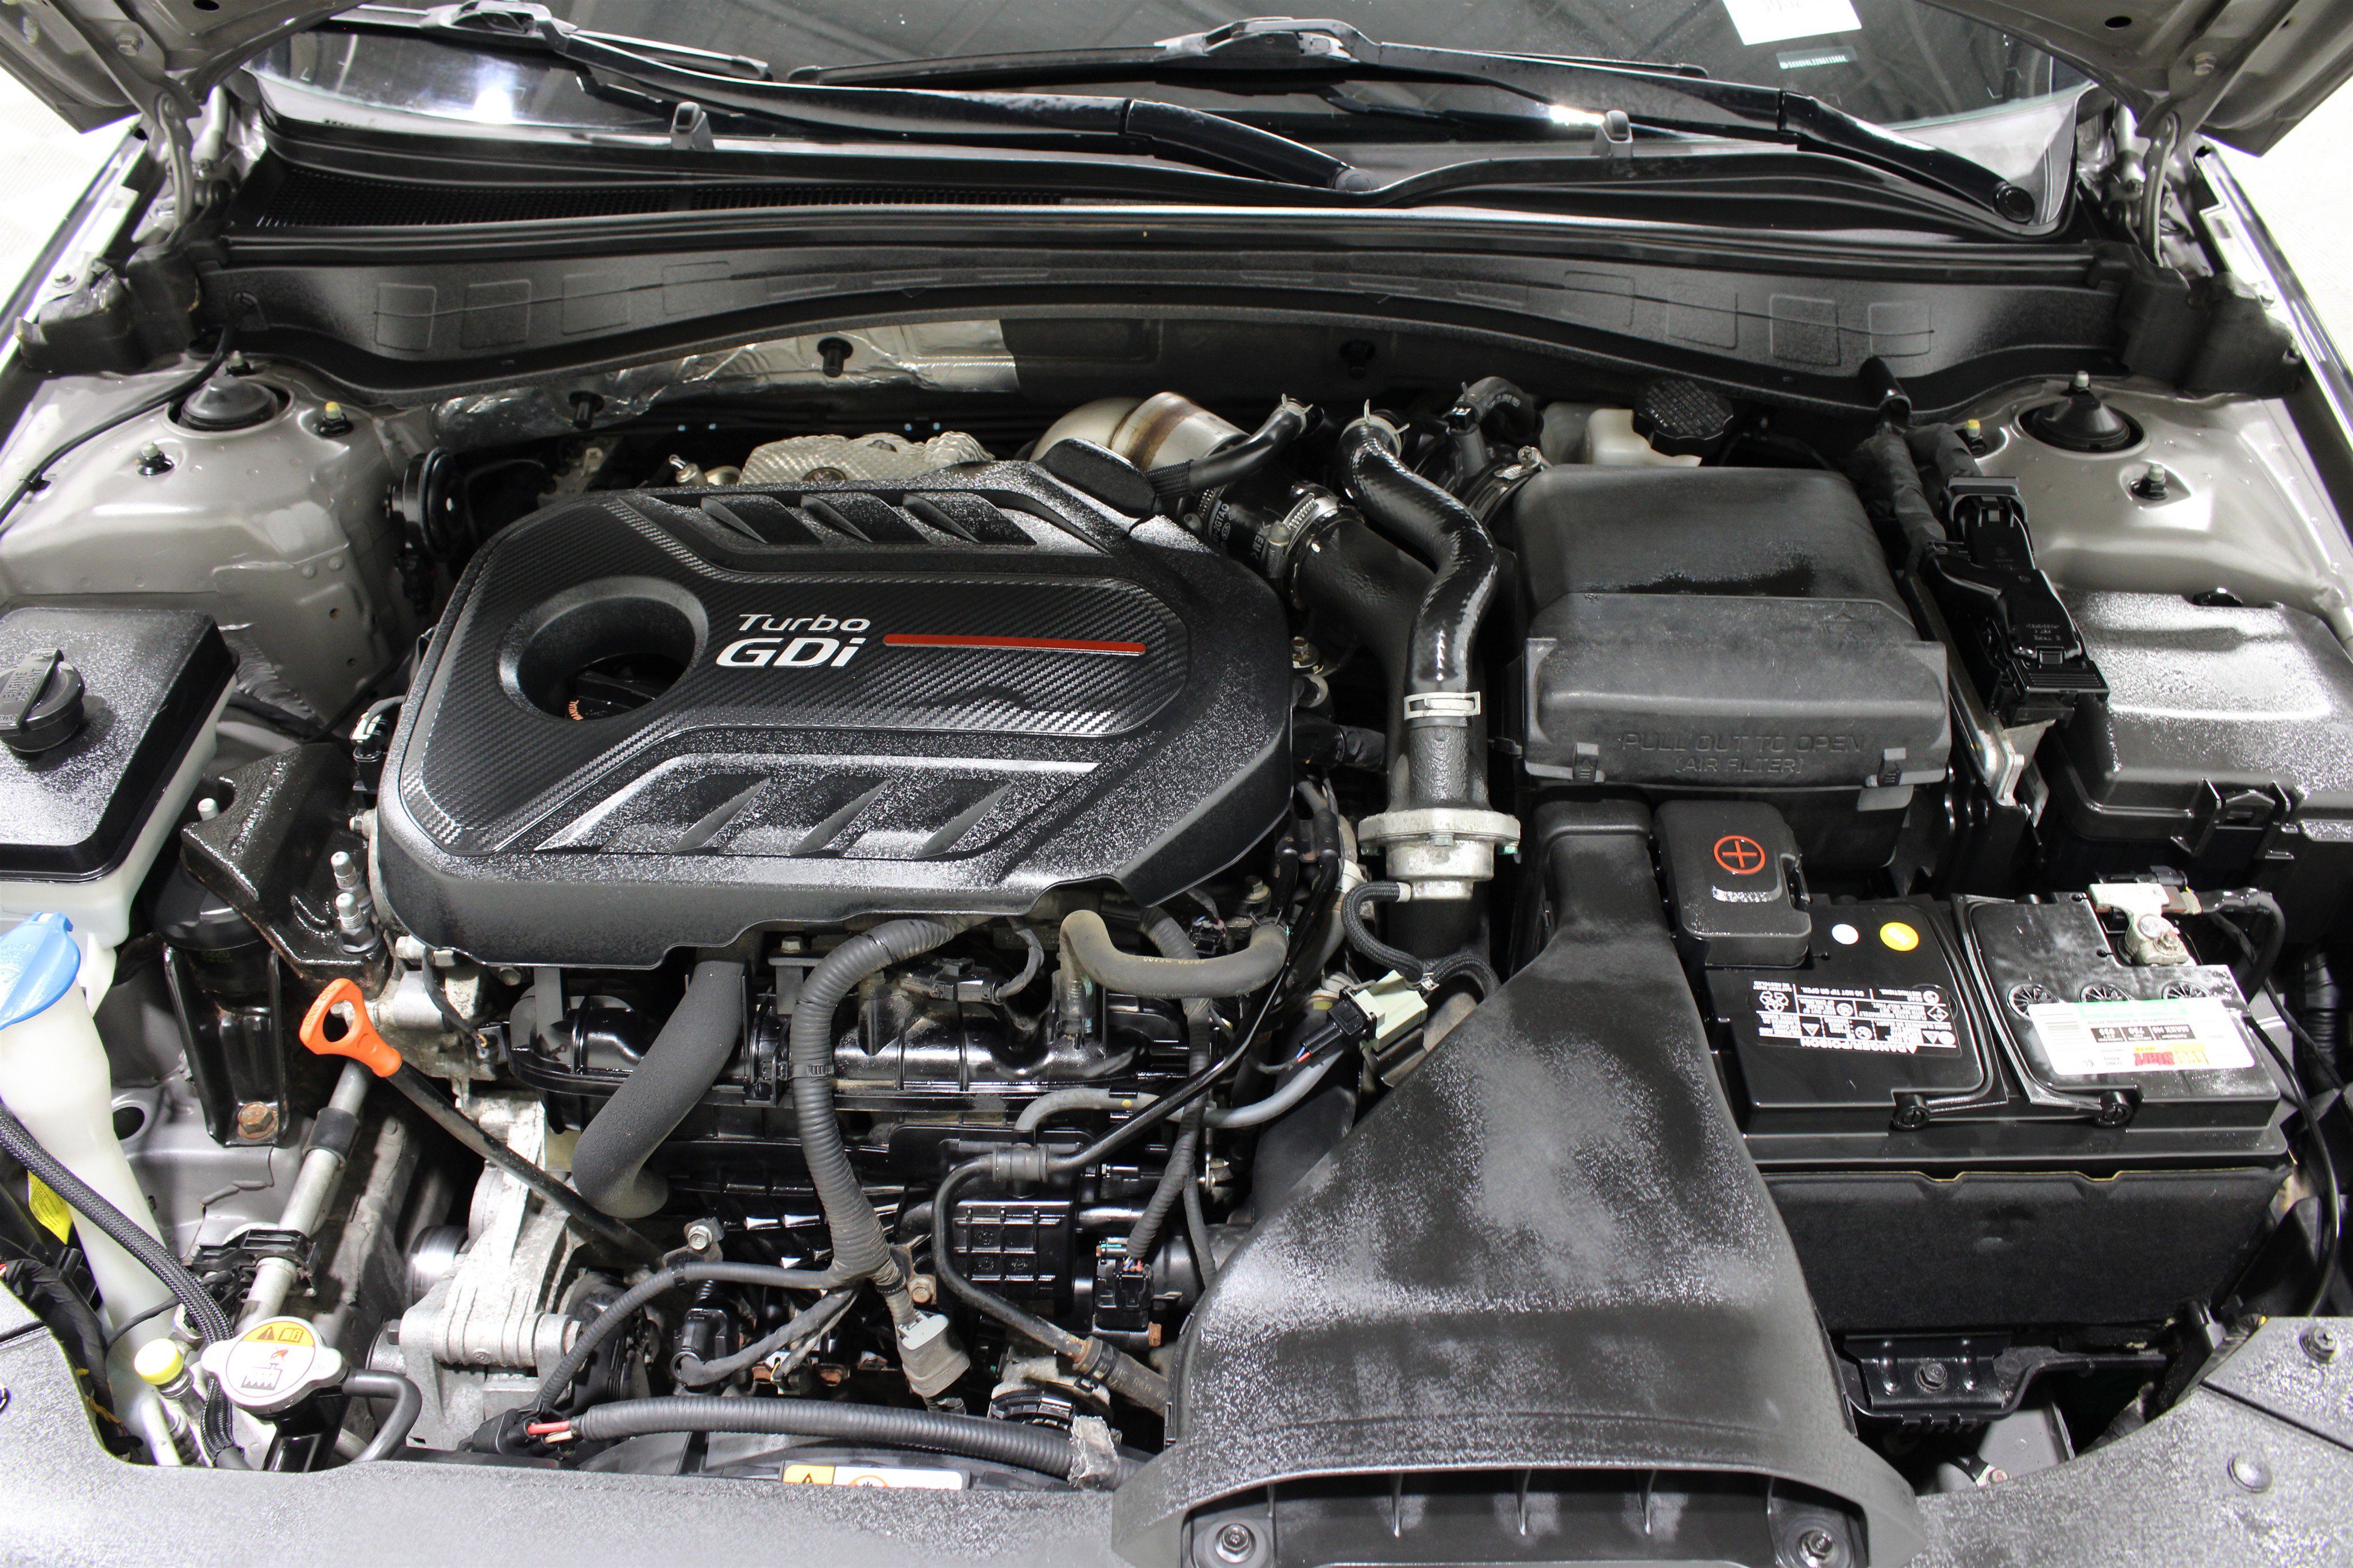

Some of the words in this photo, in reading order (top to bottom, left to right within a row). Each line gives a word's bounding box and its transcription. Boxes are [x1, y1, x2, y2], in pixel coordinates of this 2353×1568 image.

[739, 613, 871, 634] Turbo
[715, 636, 866, 669] GDi
[3, 672, 27, 698] ENGINE
[16, 668, 44, 702] COOLANT
[1622, 733, 1687, 751] PULL
[1695, 734, 1750, 752] OUT
[1756, 734, 1787, 753] TO
[1795, 735, 1865, 754] OPEN
[304, 1005, 321, 1026] ENG
[319, 986, 336, 1002] OIL
